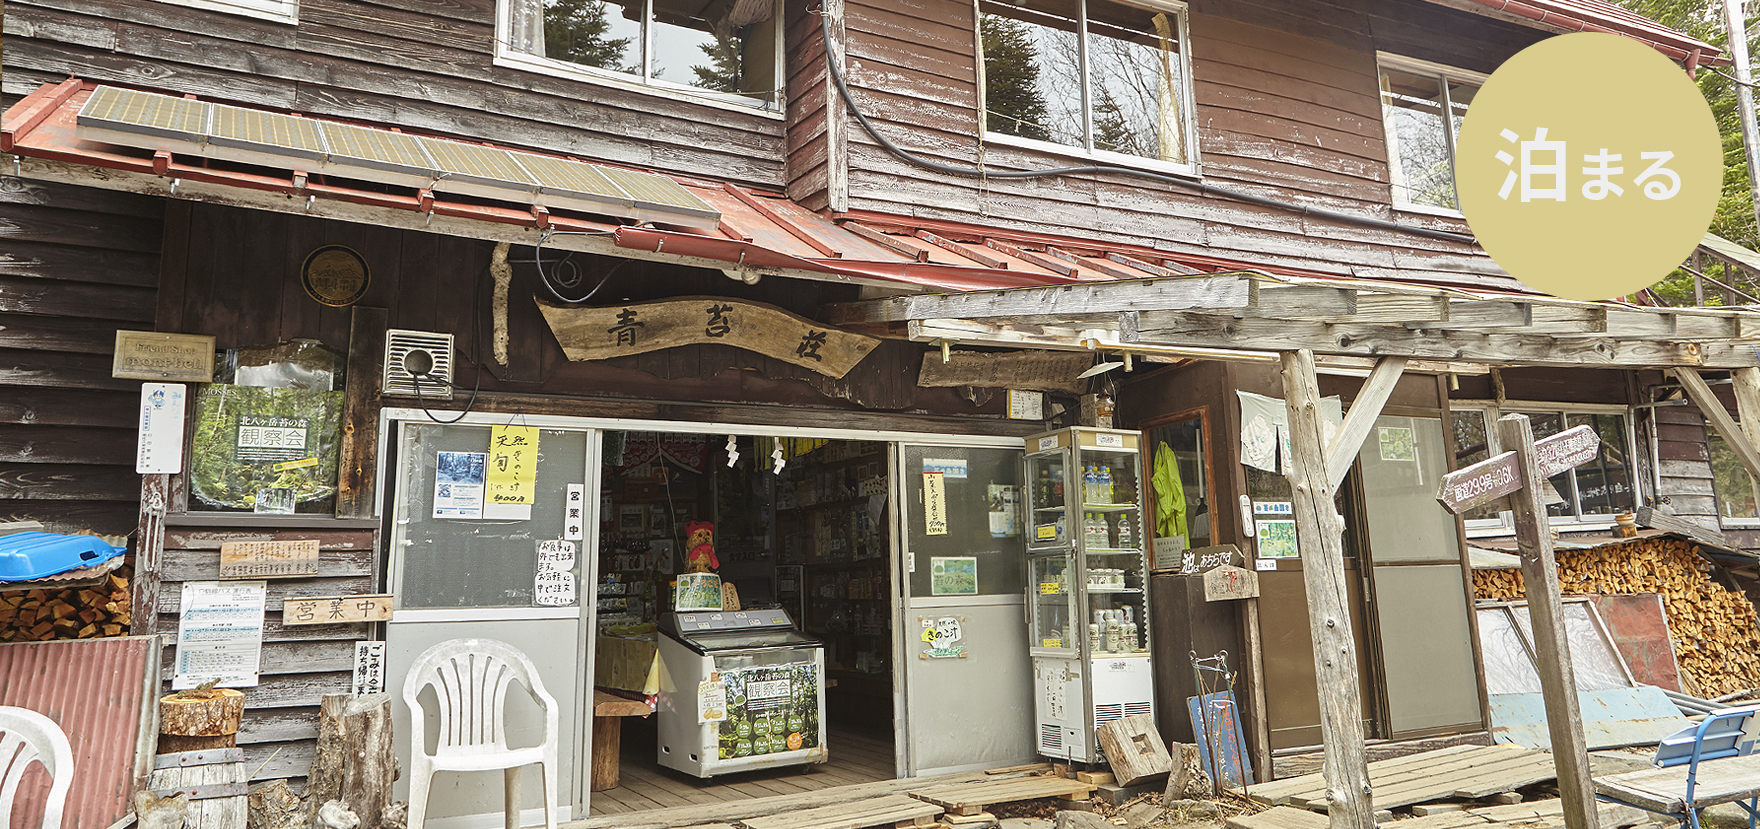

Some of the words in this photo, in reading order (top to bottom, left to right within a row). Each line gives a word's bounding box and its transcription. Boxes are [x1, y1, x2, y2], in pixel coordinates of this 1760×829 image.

[607, 304, 827, 362] 青苔荘
[170, 346, 197, 355] Shop
[203, 388, 237, 396] MOSSES
[241, 416, 308, 428] 北八ヶ岳苔の森
[241, 428, 304, 447] 観察会
[569, 491, 580, 535] 営業中
[541, 541, 572, 552] お食事は
[539, 552, 574, 561] 外でも出来
[538, 562, 554, 571] ます。
[538, 572, 571, 582] お気軽に
[537, 583, 571, 593] 中で注文
[297, 600, 375, 621] 営業中
[928, 627, 958, 641] きのこ汁
[748, 681, 790, 698] 観察会
